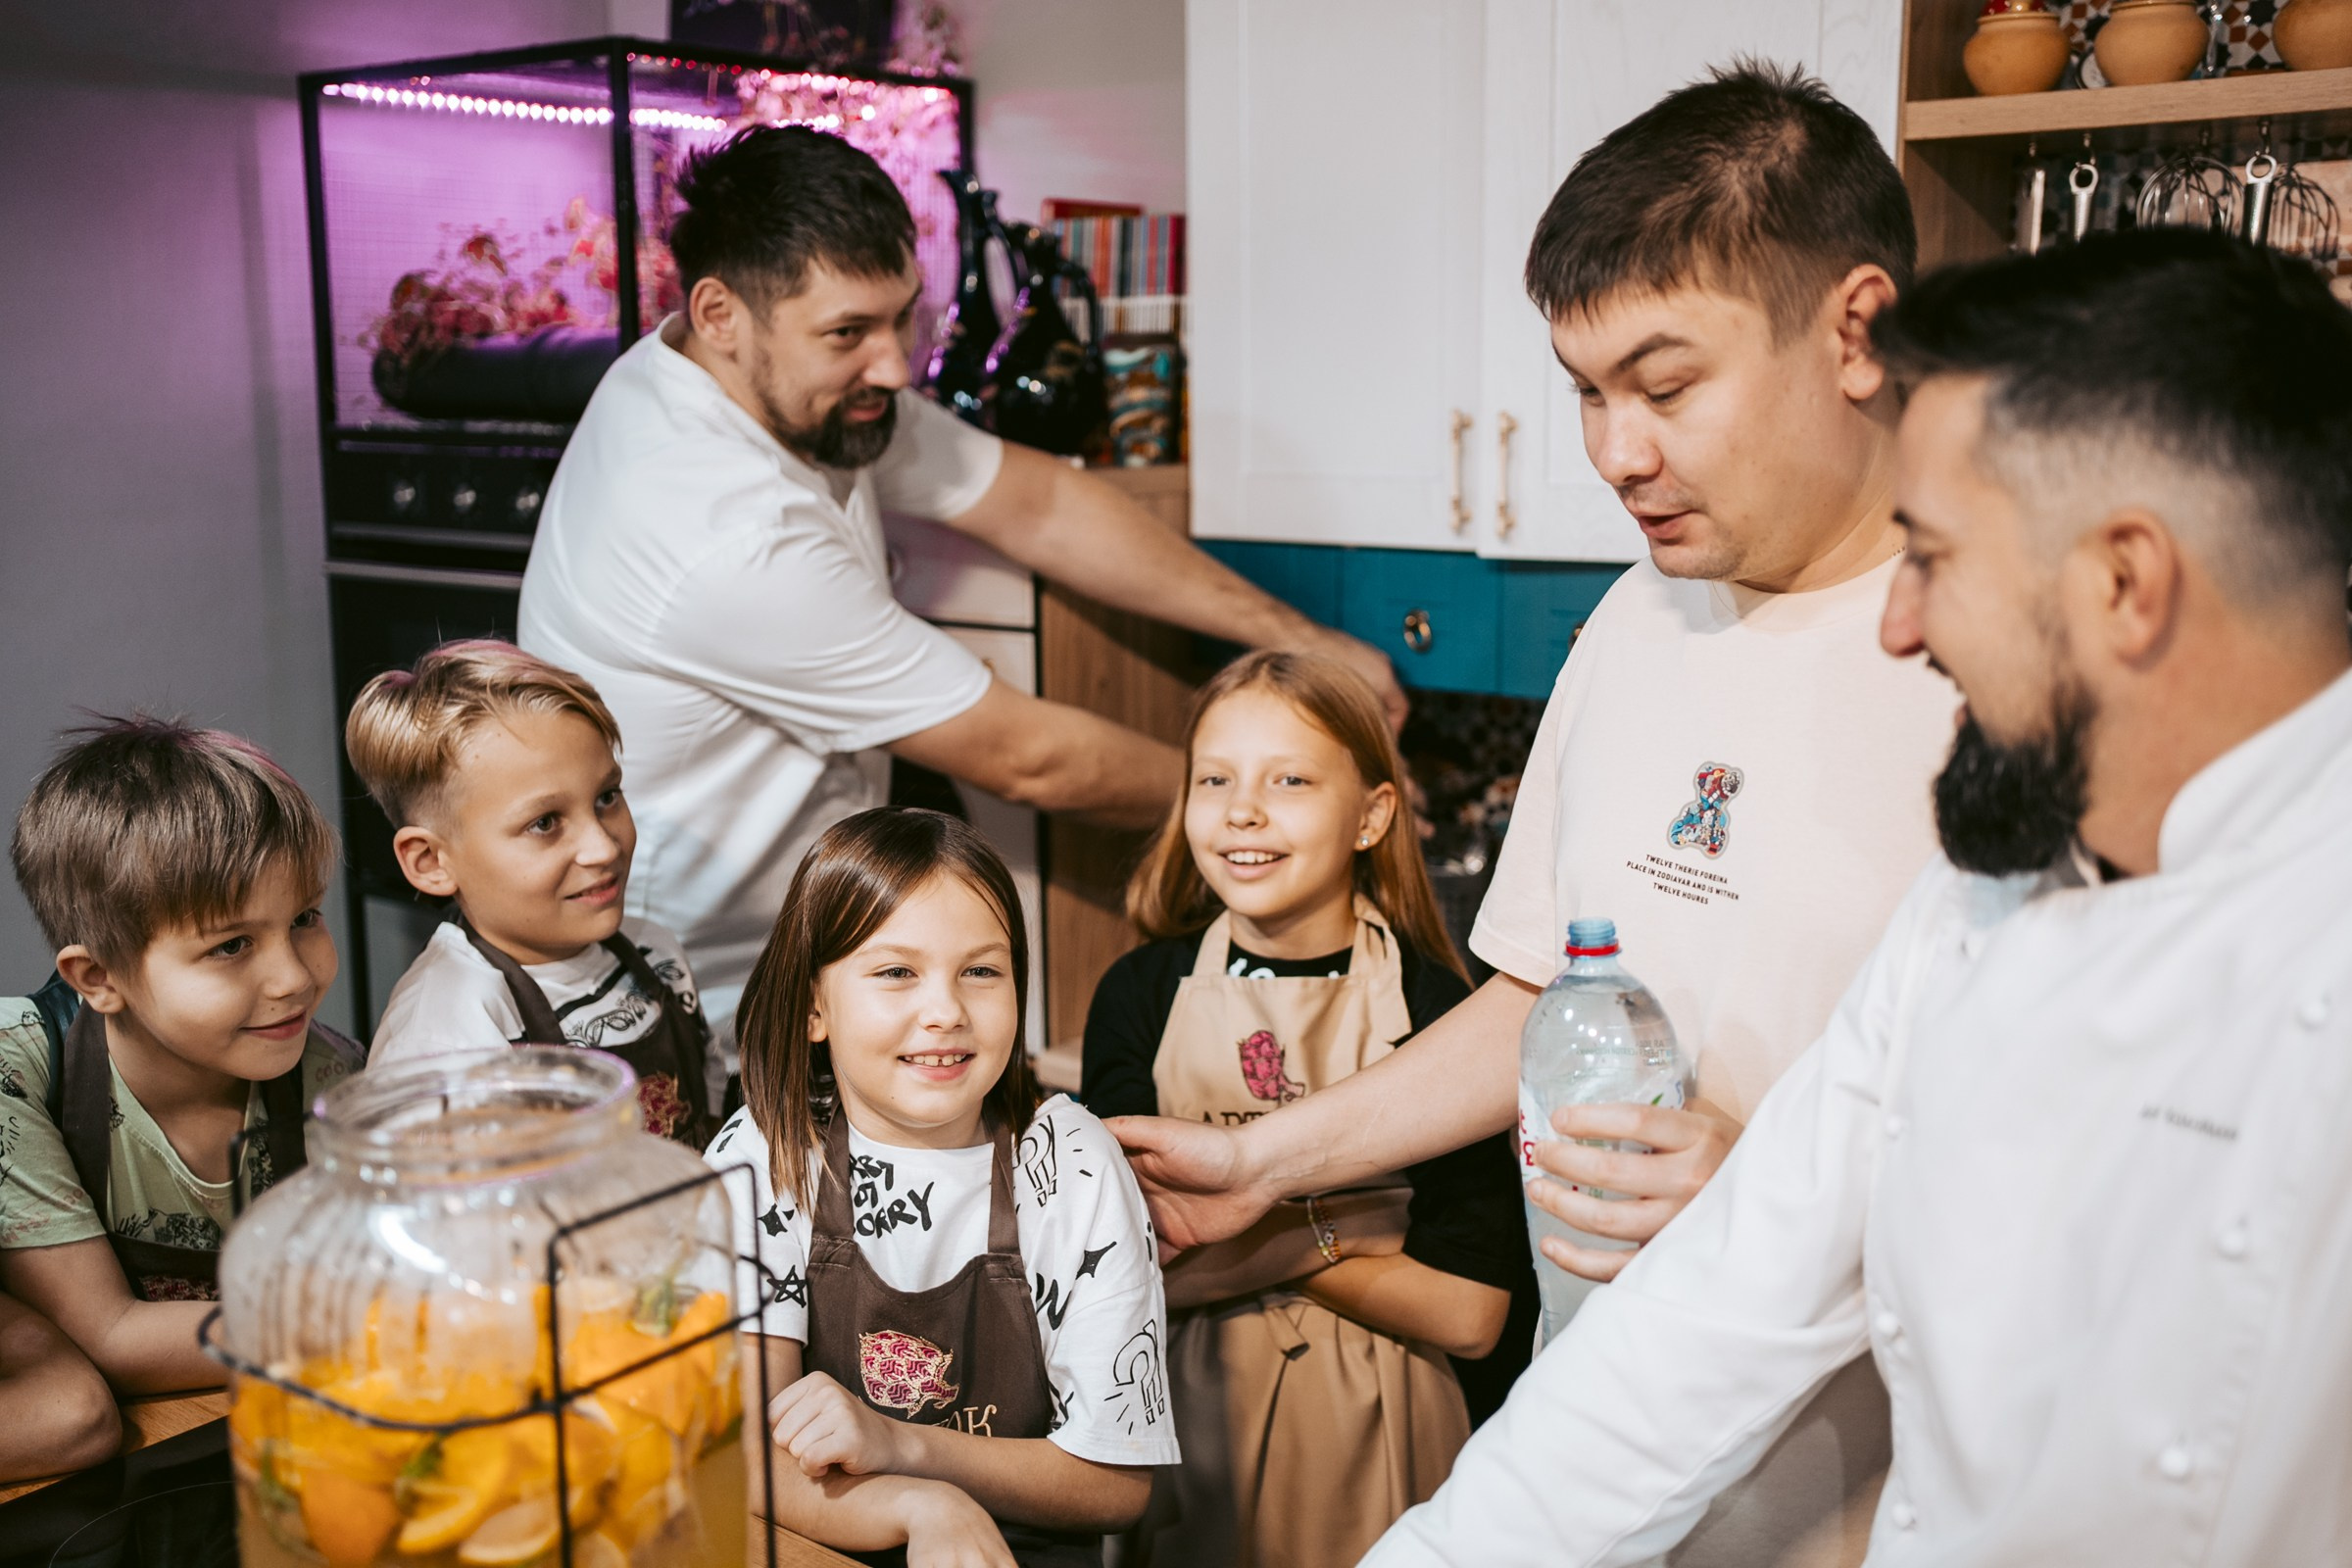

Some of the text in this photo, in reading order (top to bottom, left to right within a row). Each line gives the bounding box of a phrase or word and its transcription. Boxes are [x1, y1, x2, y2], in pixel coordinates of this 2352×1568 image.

[1645, 854, 1673, 869] TWELVE
[1626, 860, 1647, 873] PLACE
[1647, 867, 1656, 876] IN
[1691, 882, 1706, 892] AND
[1652, 881, 1709, 906] TWELVE HOURES
[853, 1181, 934, 1239] ORRY
